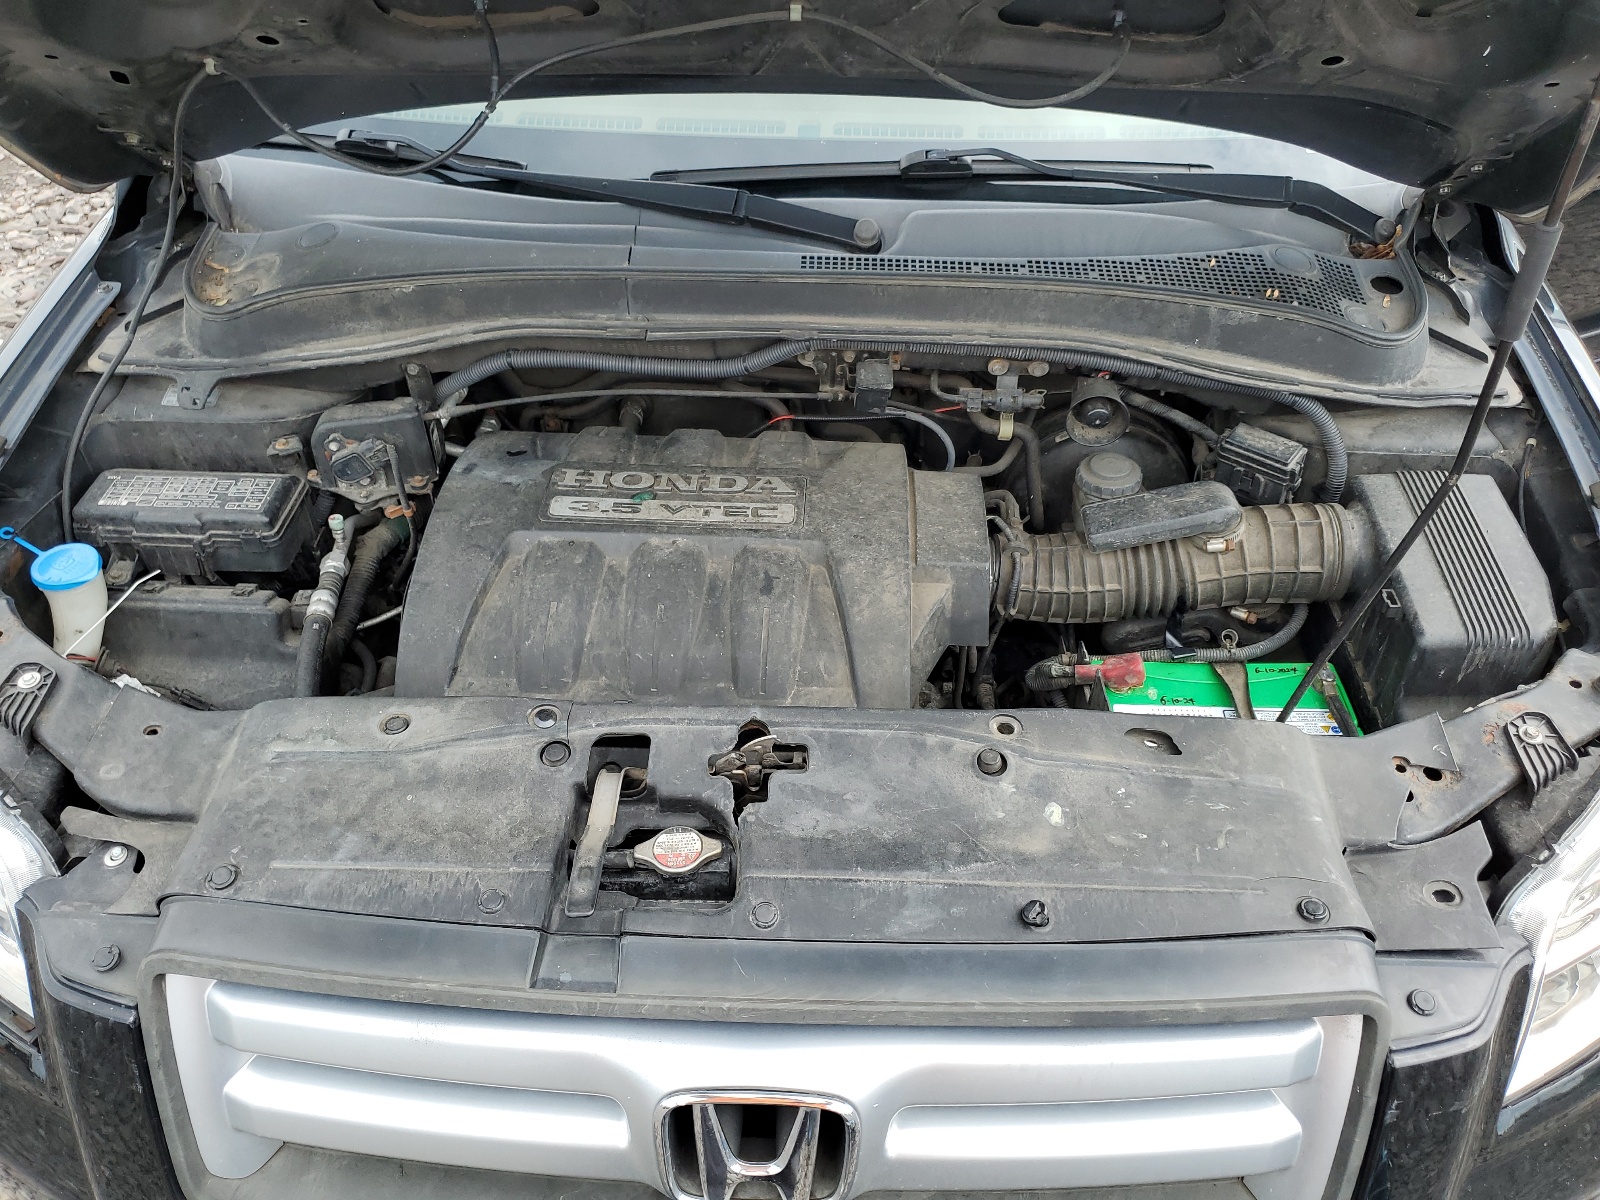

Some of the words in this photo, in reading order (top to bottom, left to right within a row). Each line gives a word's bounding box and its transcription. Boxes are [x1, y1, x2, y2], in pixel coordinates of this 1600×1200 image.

[557, 468, 797, 496] HONDA
[568, 500, 644, 515] 3.5
[660, 503, 780, 519] VTEC
